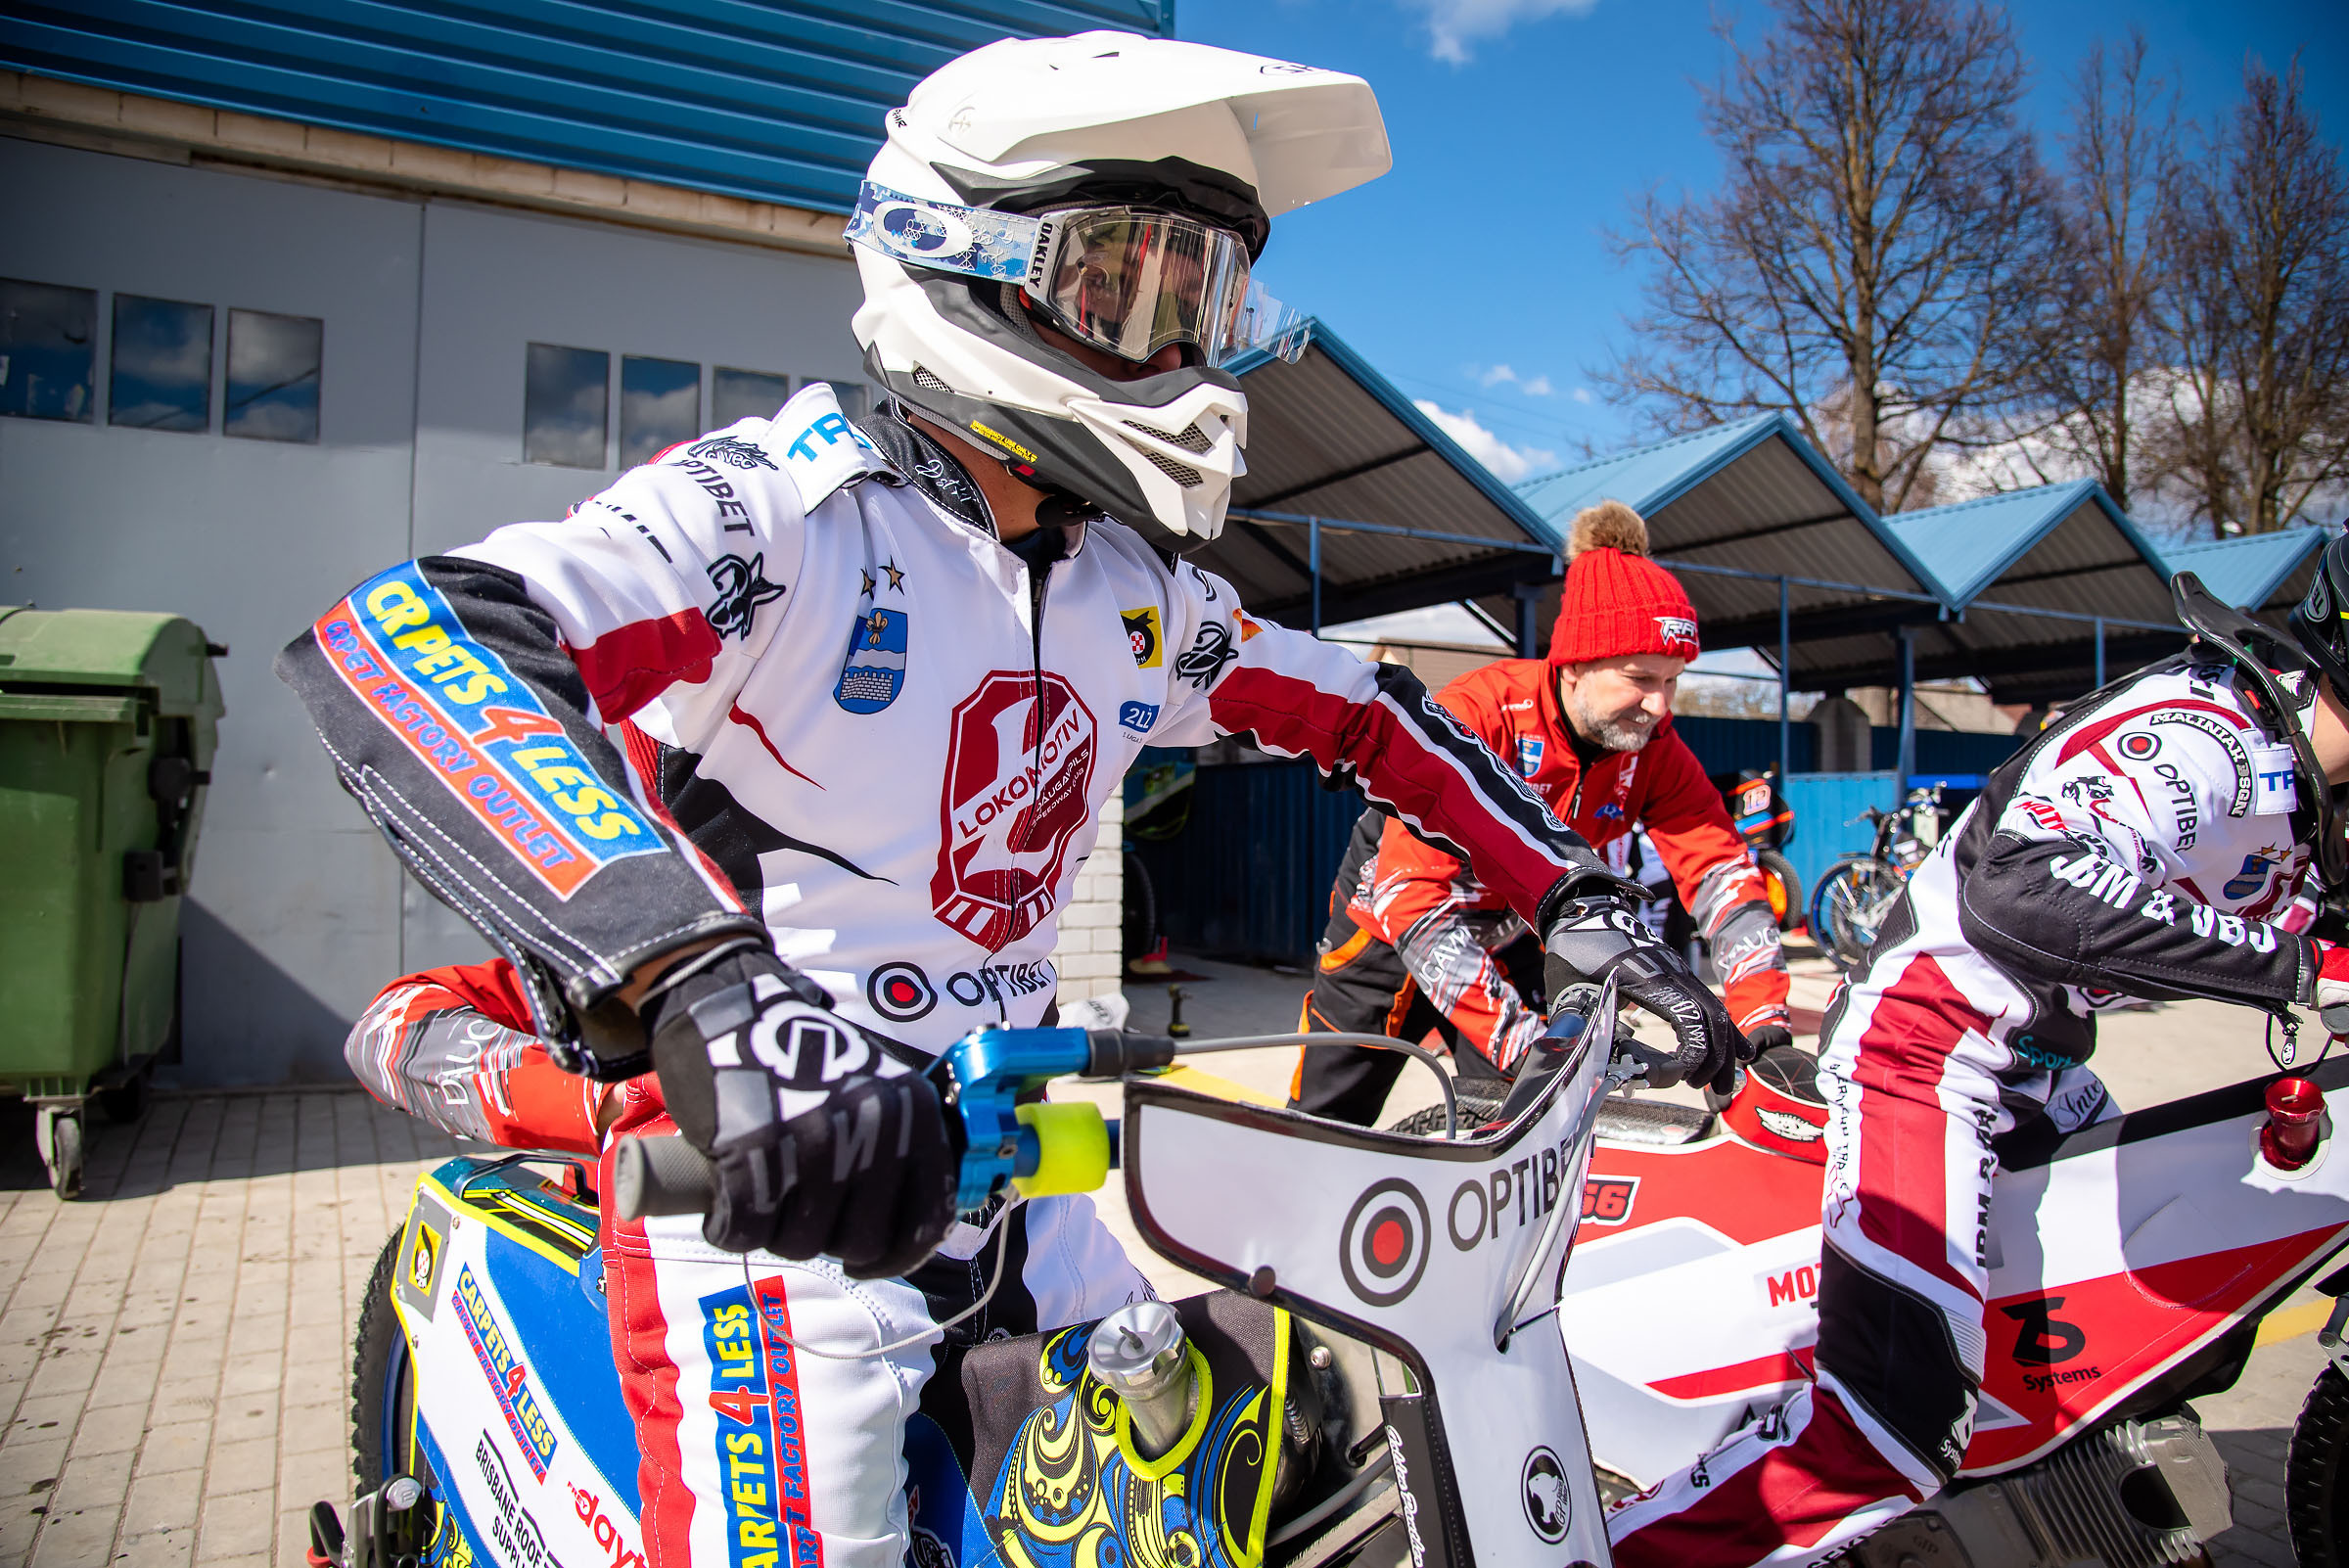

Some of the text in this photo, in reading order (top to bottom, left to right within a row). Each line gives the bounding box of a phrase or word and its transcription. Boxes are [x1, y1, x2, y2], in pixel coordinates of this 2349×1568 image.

[1030, 222, 1053, 289] OAKLEY
[668, 459, 755, 536] PTIBET
[366, 580, 640, 840] CRPETS 4 LESS
[371, 675, 480, 774] FACTORY
[470, 774, 576, 869] OUTLET
[958, 709, 1080, 839] LOKOMOTIV
[2141, 889, 2176, 925] &
[1448, 1133, 1574, 1253] OPTIBE
[460, 1270, 555, 1456] CARPETS 4 LESS
[714, 1305, 755, 1378] LESS
[762, 1293, 791, 1375] OUTLET
[452, 1295, 544, 1477] CARPET FACTORY OUTLET
[708, 1385, 770, 1426] 4
[2022, 1366, 2102, 1394] Systems
[476, 1438, 516, 1528] BRISBANE
[774, 1382, 805, 1499] FACTORY
